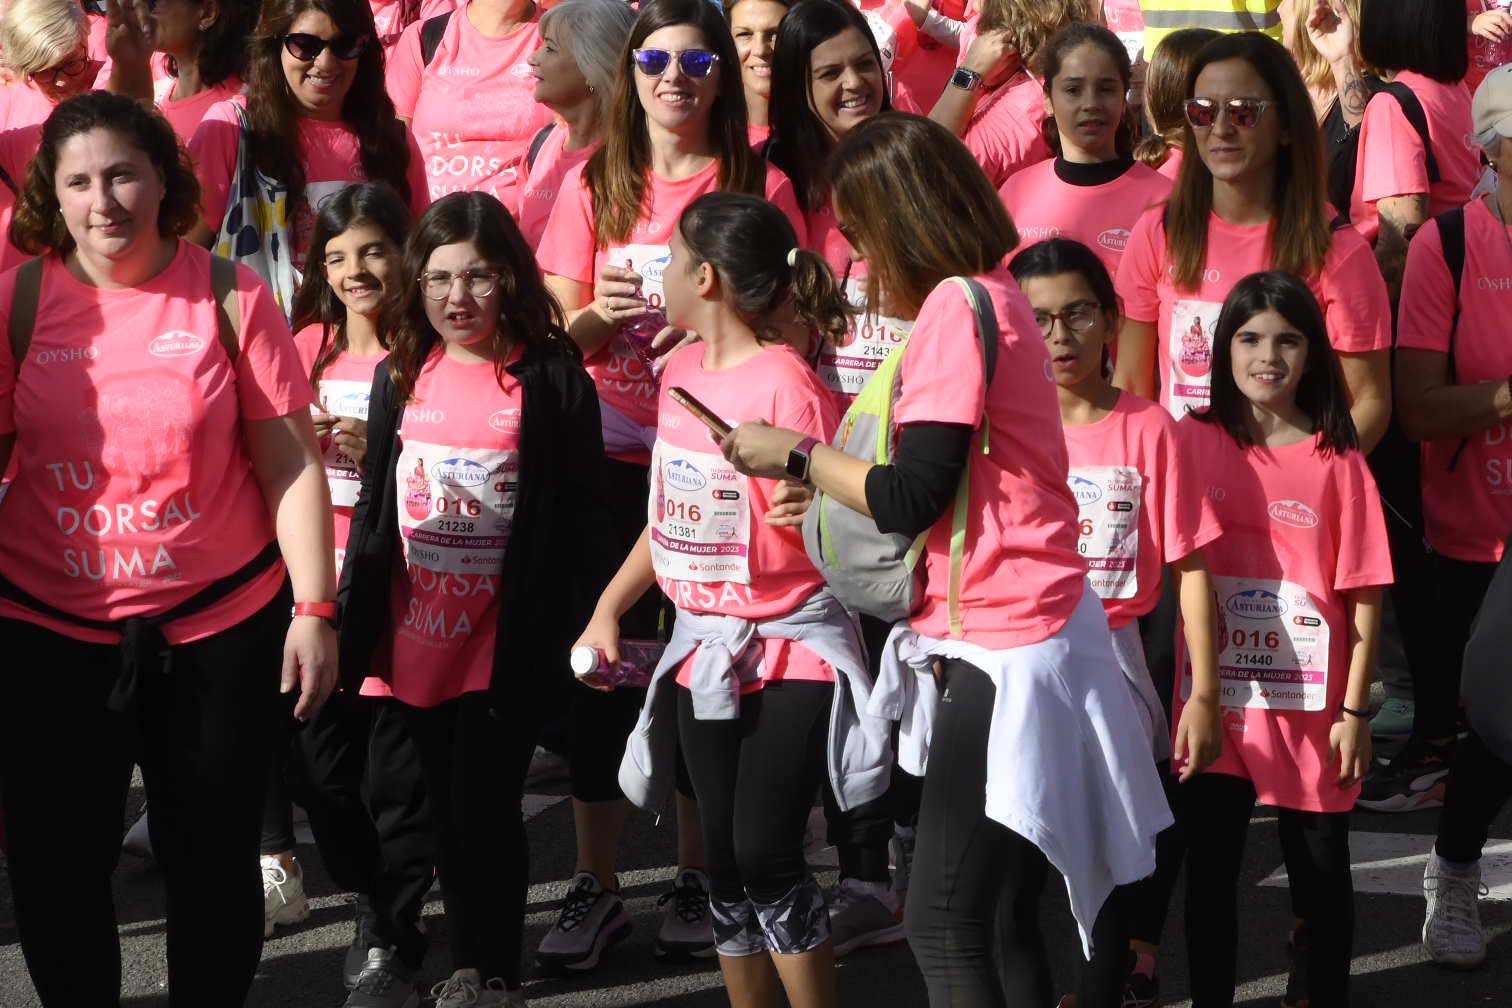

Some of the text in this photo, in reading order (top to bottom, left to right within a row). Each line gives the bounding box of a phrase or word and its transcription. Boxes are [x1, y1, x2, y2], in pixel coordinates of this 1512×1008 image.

[36, 346, 98, 365] OYSHO
[46, 461, 94, 491] TU
[436, 467, 488, 482] ASTURIANA
[667, 469, 702, 487] ASTURIANA
[711, 472, 738, 481] SUMA
[57, 492, 201, 536] DORSAL
[436, 496, 482, 517] 016
[666, 498, 701, 523] 016
[1271, 506, 1315, 525] ASTURIANA
[438, 520, 475, 533] 21238
[668, 523, 697, 539] 21381
[440, 536, 451, 544] DE
[670, 541, 679, 550] DE
[680, 543, 690, 552] LA
[690, 544, 718, 554] MUJER
[63, 544, 177, 580] SUMA
[1231, 598, 1284, 614] ASTURIANA
[1232, 629, 1280, 650] 016
[1235, 653, 1273, 666] 21440
[1238, 669, 1250, 679] DE
[1250, 670, 1263, 680] LA
[1264, 671, 1292, 681] MUJER
[1271, 689, 1315, 700] Santander
